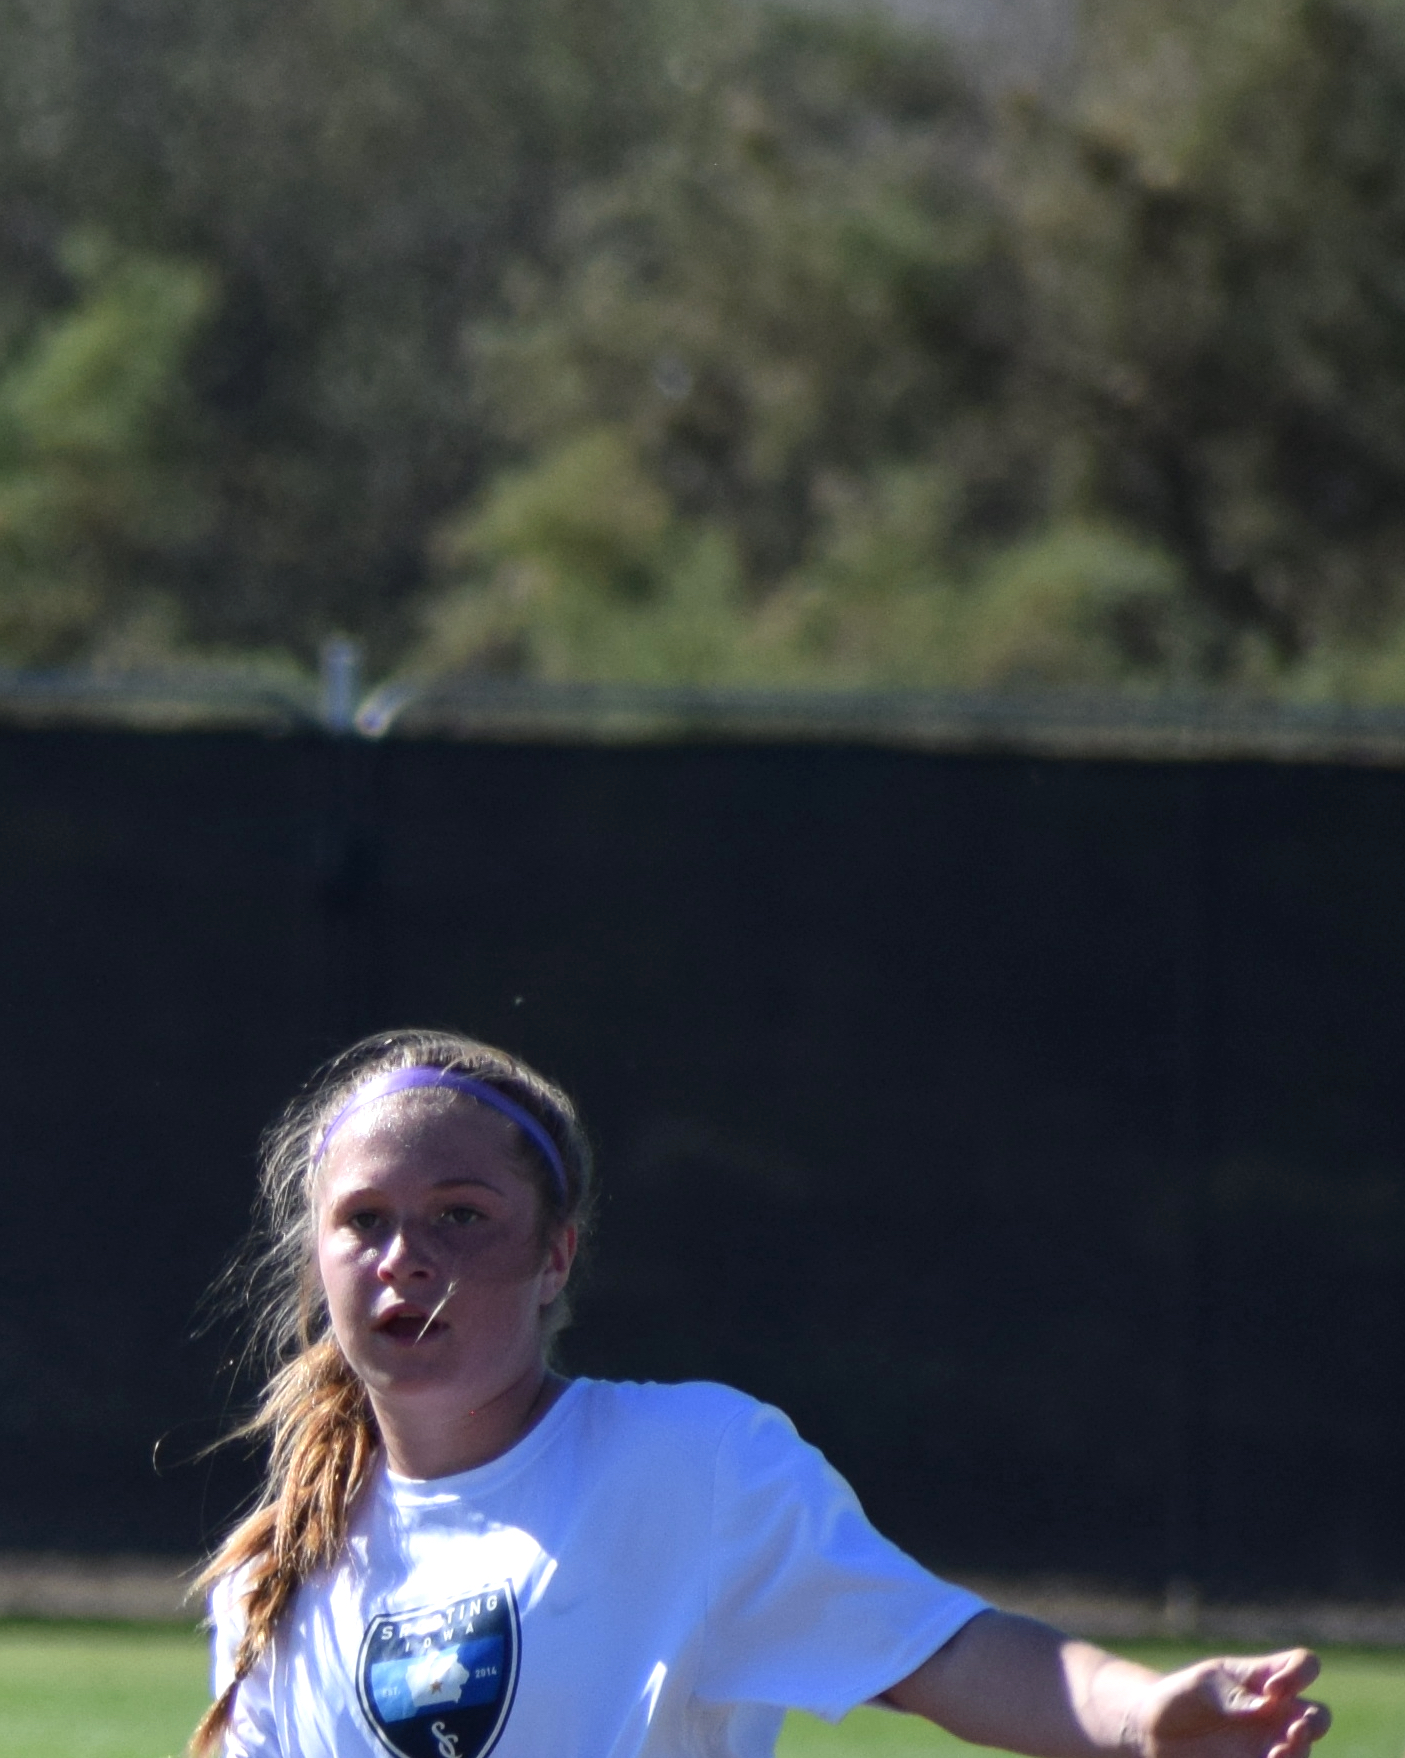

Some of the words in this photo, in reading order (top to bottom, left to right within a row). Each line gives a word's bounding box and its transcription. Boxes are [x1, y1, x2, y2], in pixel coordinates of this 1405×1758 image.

[380, 1594, 498, 1641] SPTING
[404, 1622, 474, 1653] IOWA
[475, 1668, 497, 1679] 2014
